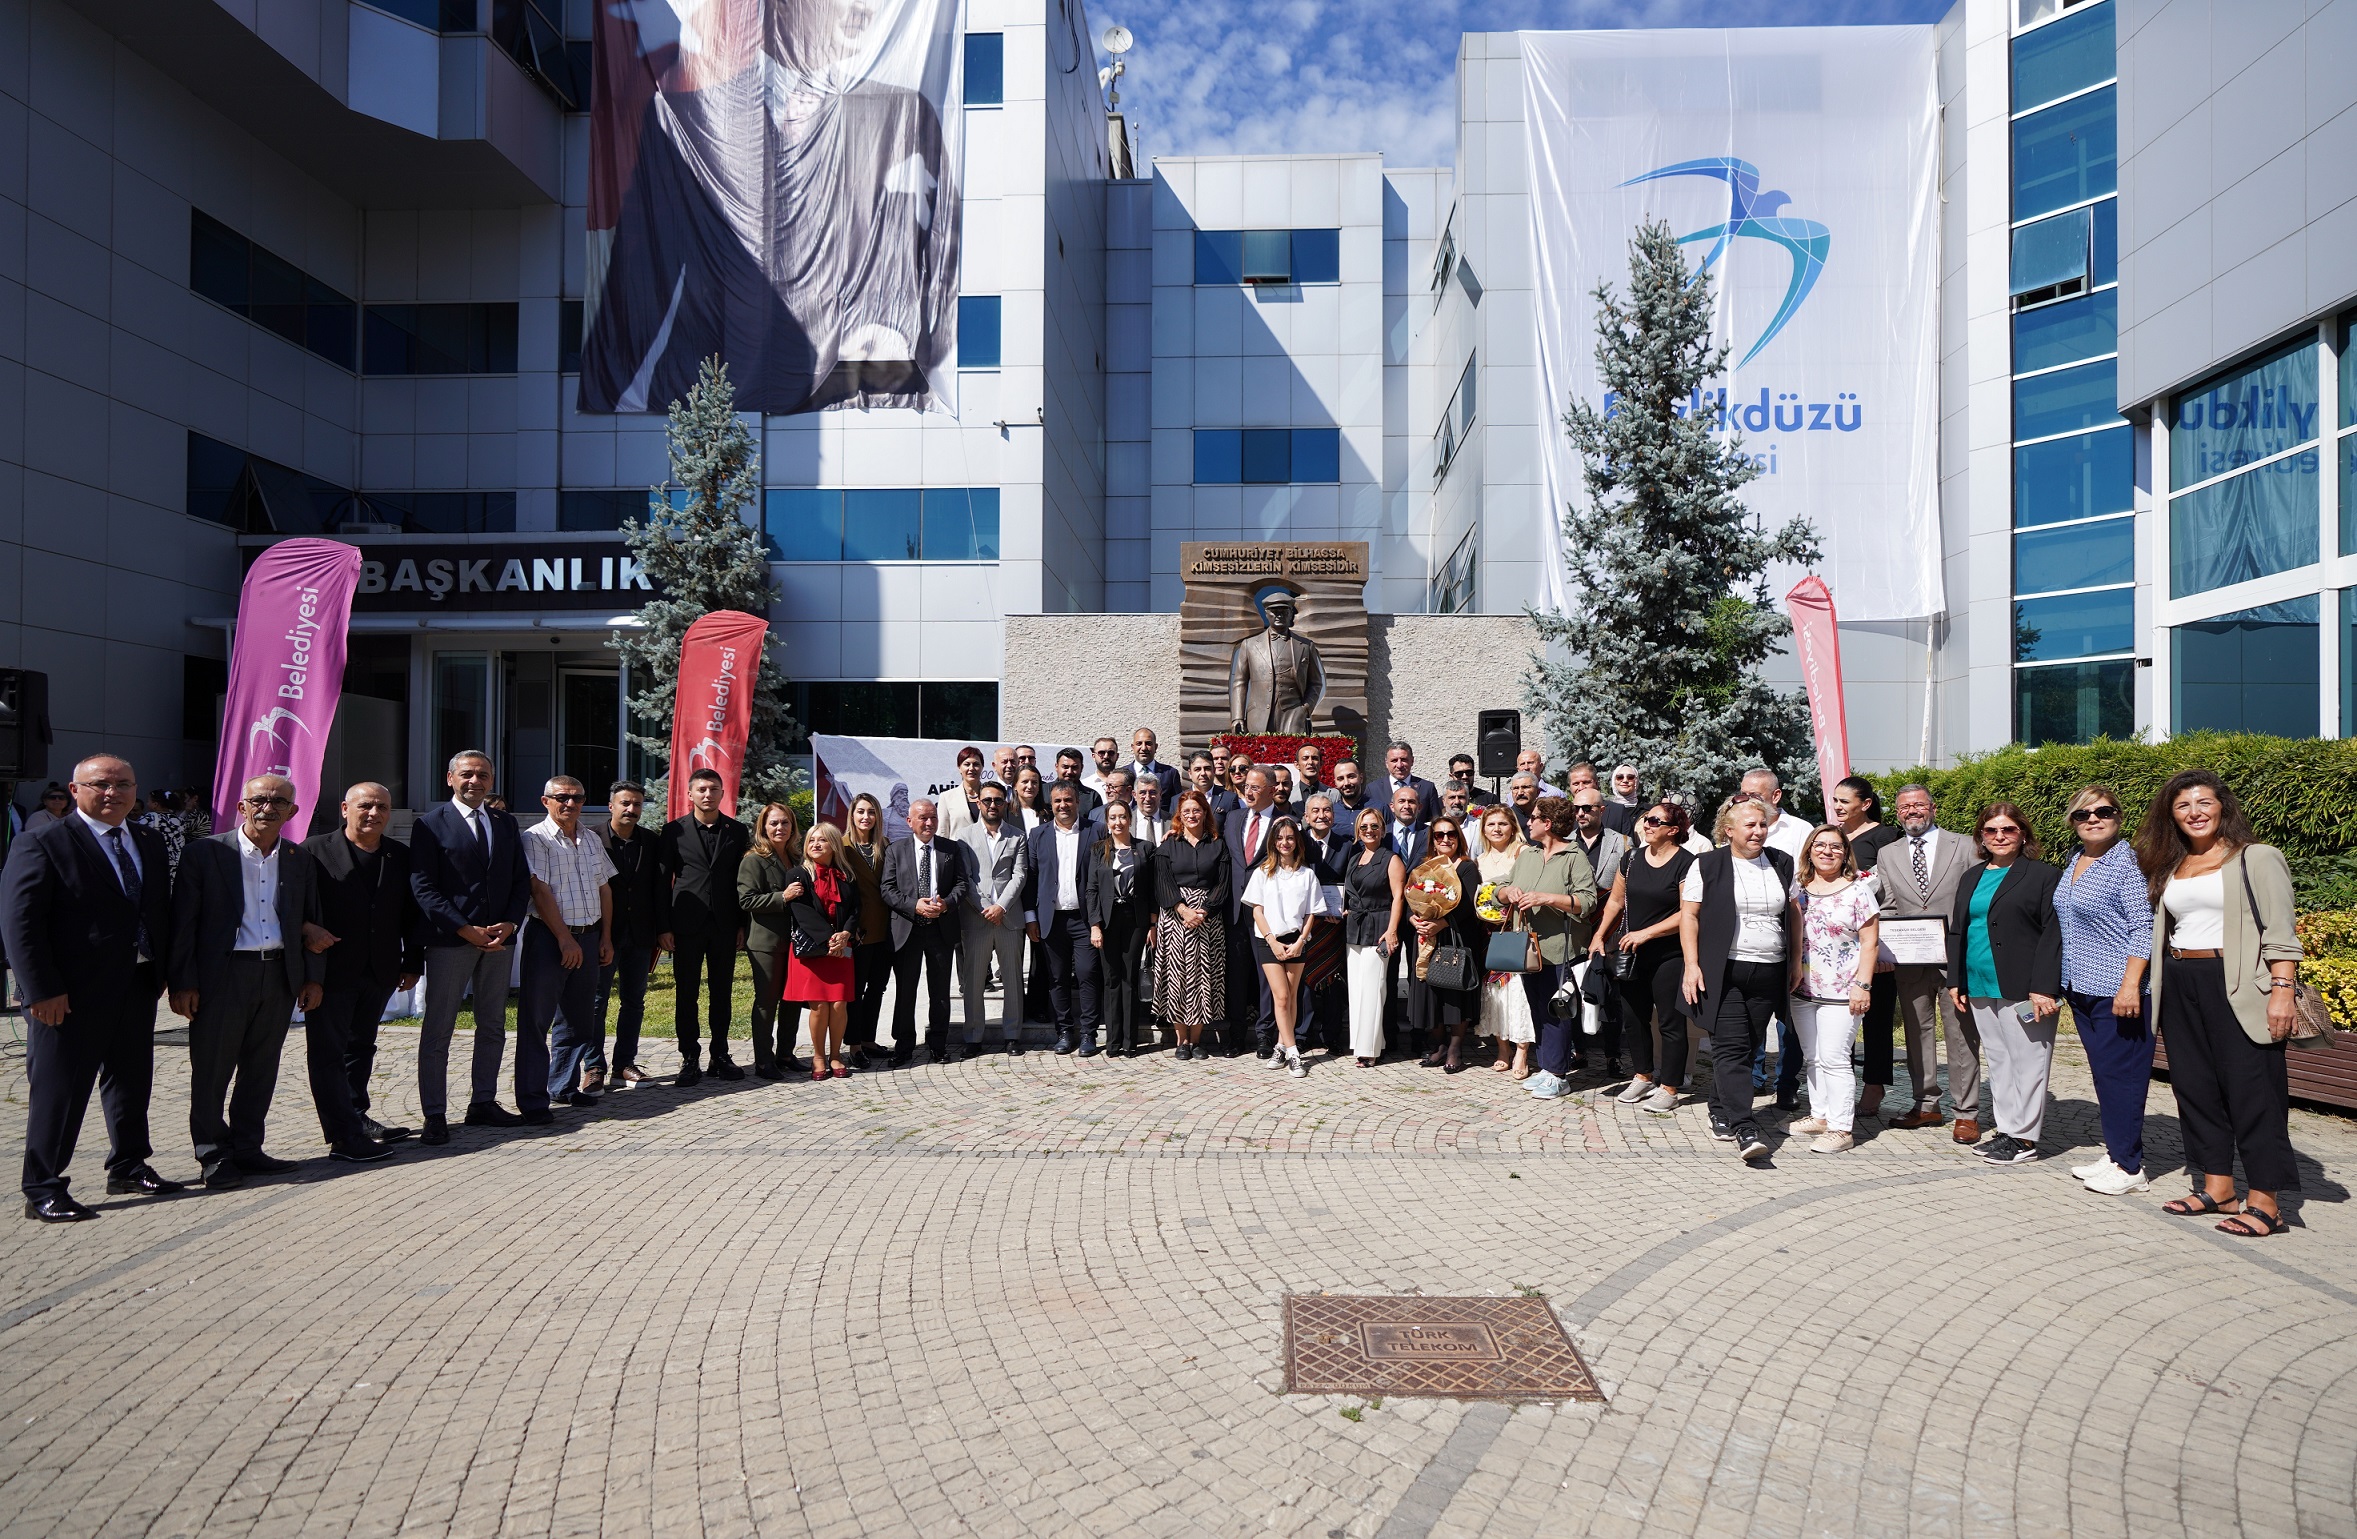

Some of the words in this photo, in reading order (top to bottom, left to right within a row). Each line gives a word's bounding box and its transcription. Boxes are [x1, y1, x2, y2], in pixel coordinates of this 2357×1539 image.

[1604, 387, 1862, 432] likdüzü
[357, 557, 655, 601] BAŞKANLIK
[278, 586, 321, 700] Belediyesi
[706, 646, 736, 732] Belediyesi
[927, 781, 960, 796] AHİ
[1387, 1343, 1478, 1352] TELEKOM
